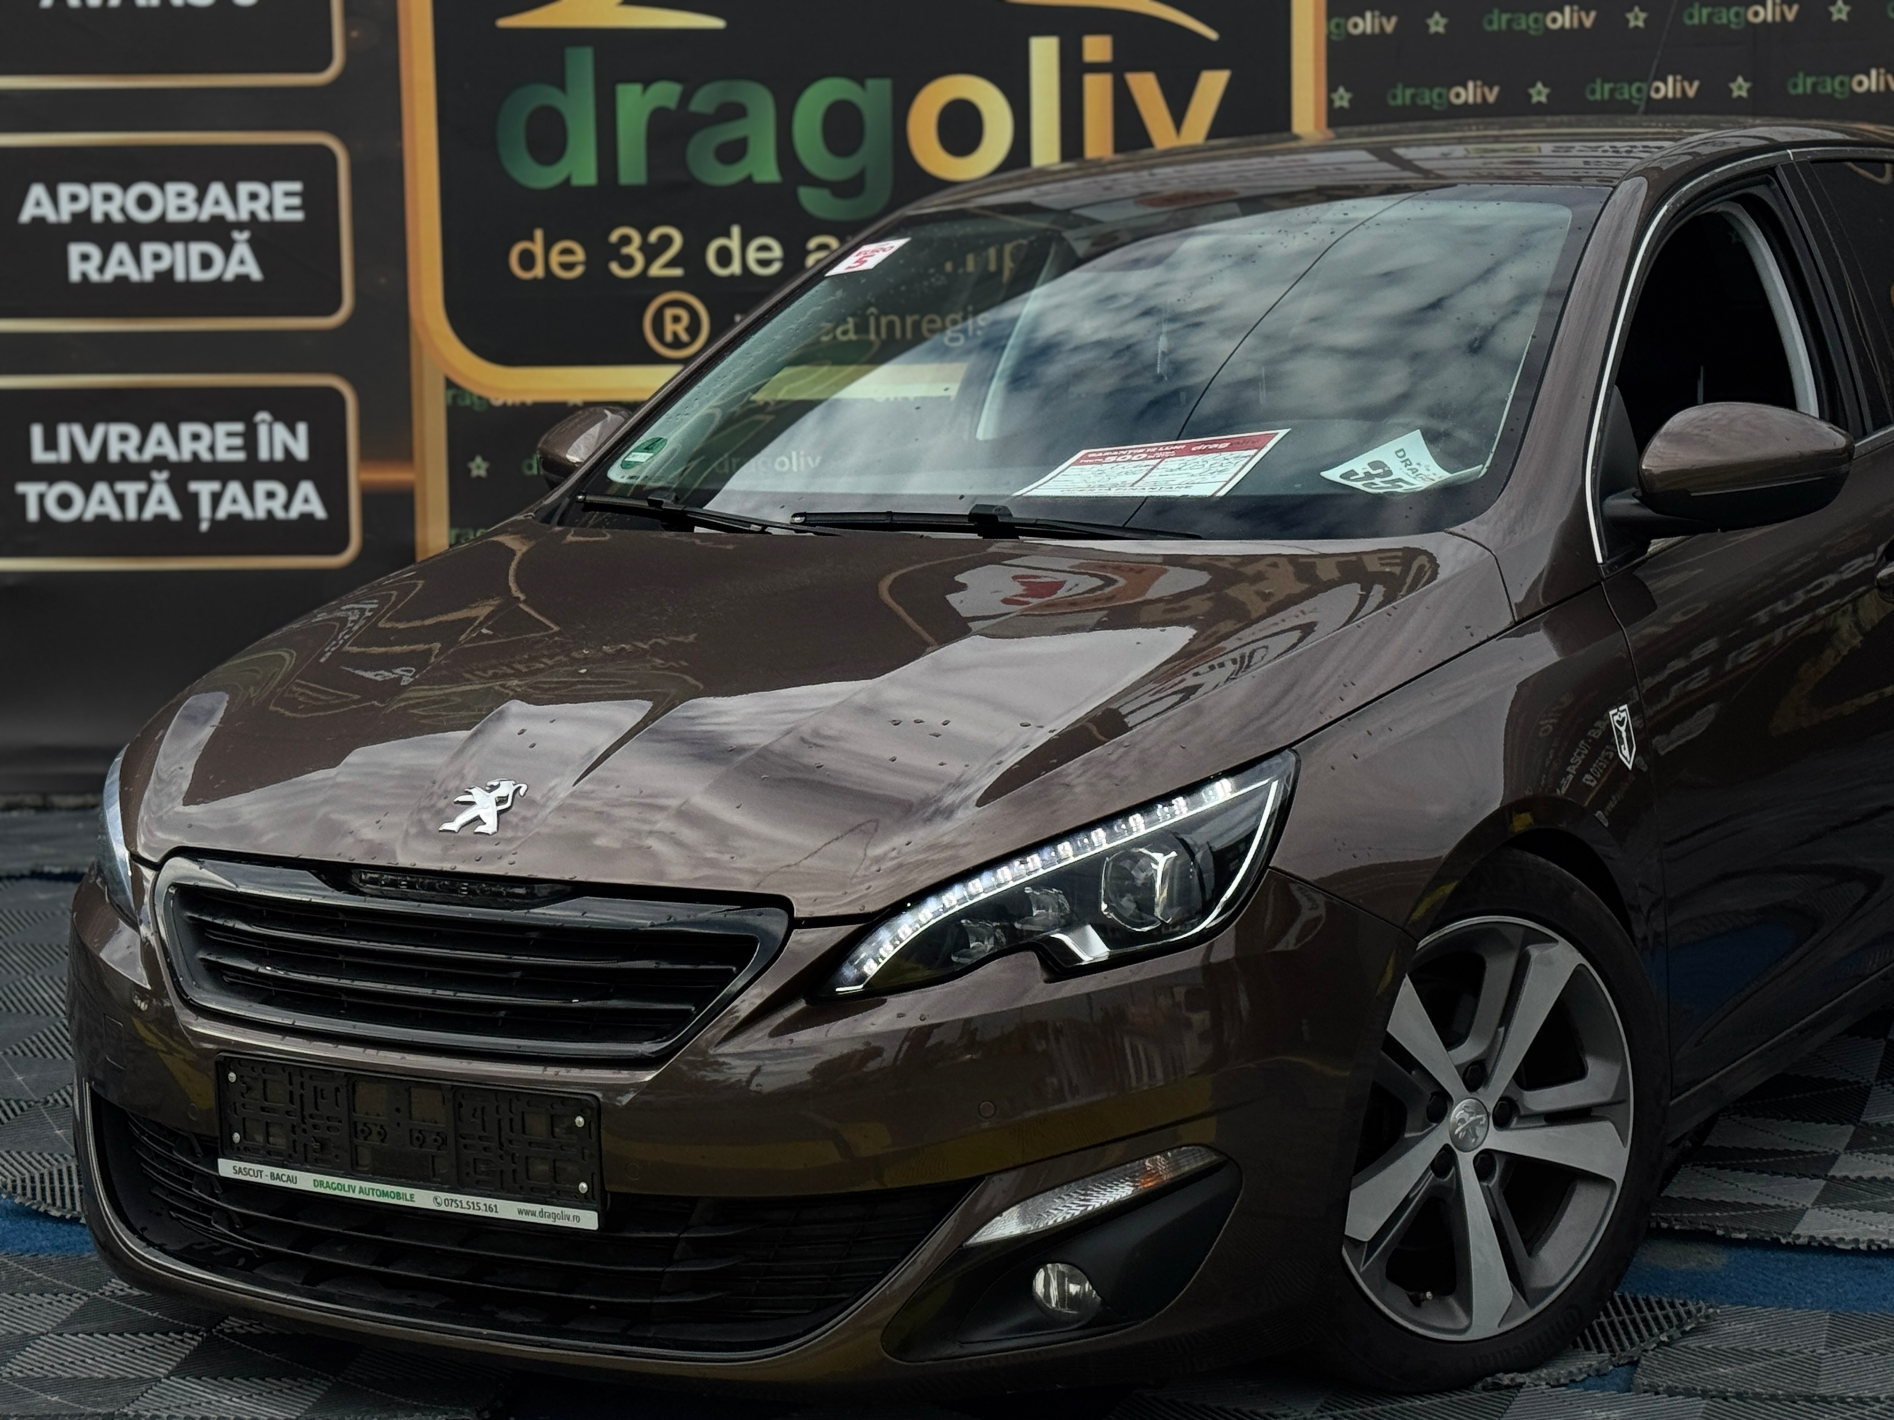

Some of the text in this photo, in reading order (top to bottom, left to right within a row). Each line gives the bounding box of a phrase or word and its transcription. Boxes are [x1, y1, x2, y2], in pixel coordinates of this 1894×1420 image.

[1326, 10, 1398, 41] goliv
[1482, 4, 1598, 36] dragoliv
[1682, 0, 1800, 30] dragoliv
[1386, 80, 1500, 110] dragoliv
[1585, 74, 1700, 105] dragoliv
[495, 34, 1232, 221] dragoliv
[18, 180, 305, 224] APROBARE
[67, 231, 264, 283] RAPIDĂ
[507, 227, 586, 280] de
[608, 226, 685, 278] 32
[705, 224, 784, 277] de
[29, 411, 309, 463] LIVRARE ÎN
[15, 470, 327, 532] TOATĂ ȚARA
[232, 1165, 264, 1180] SASCUT
[270, 1171, 298, 1185] BACAU
[313, 1178, 356, 1194] DRAGOLIV
[358, 1186, 416, 1203] AUTOMOBILE
[443, 1197, 499, 1213] 0751.515.161
[517, 1206, 581, 1224] www.dragoliv.ro
